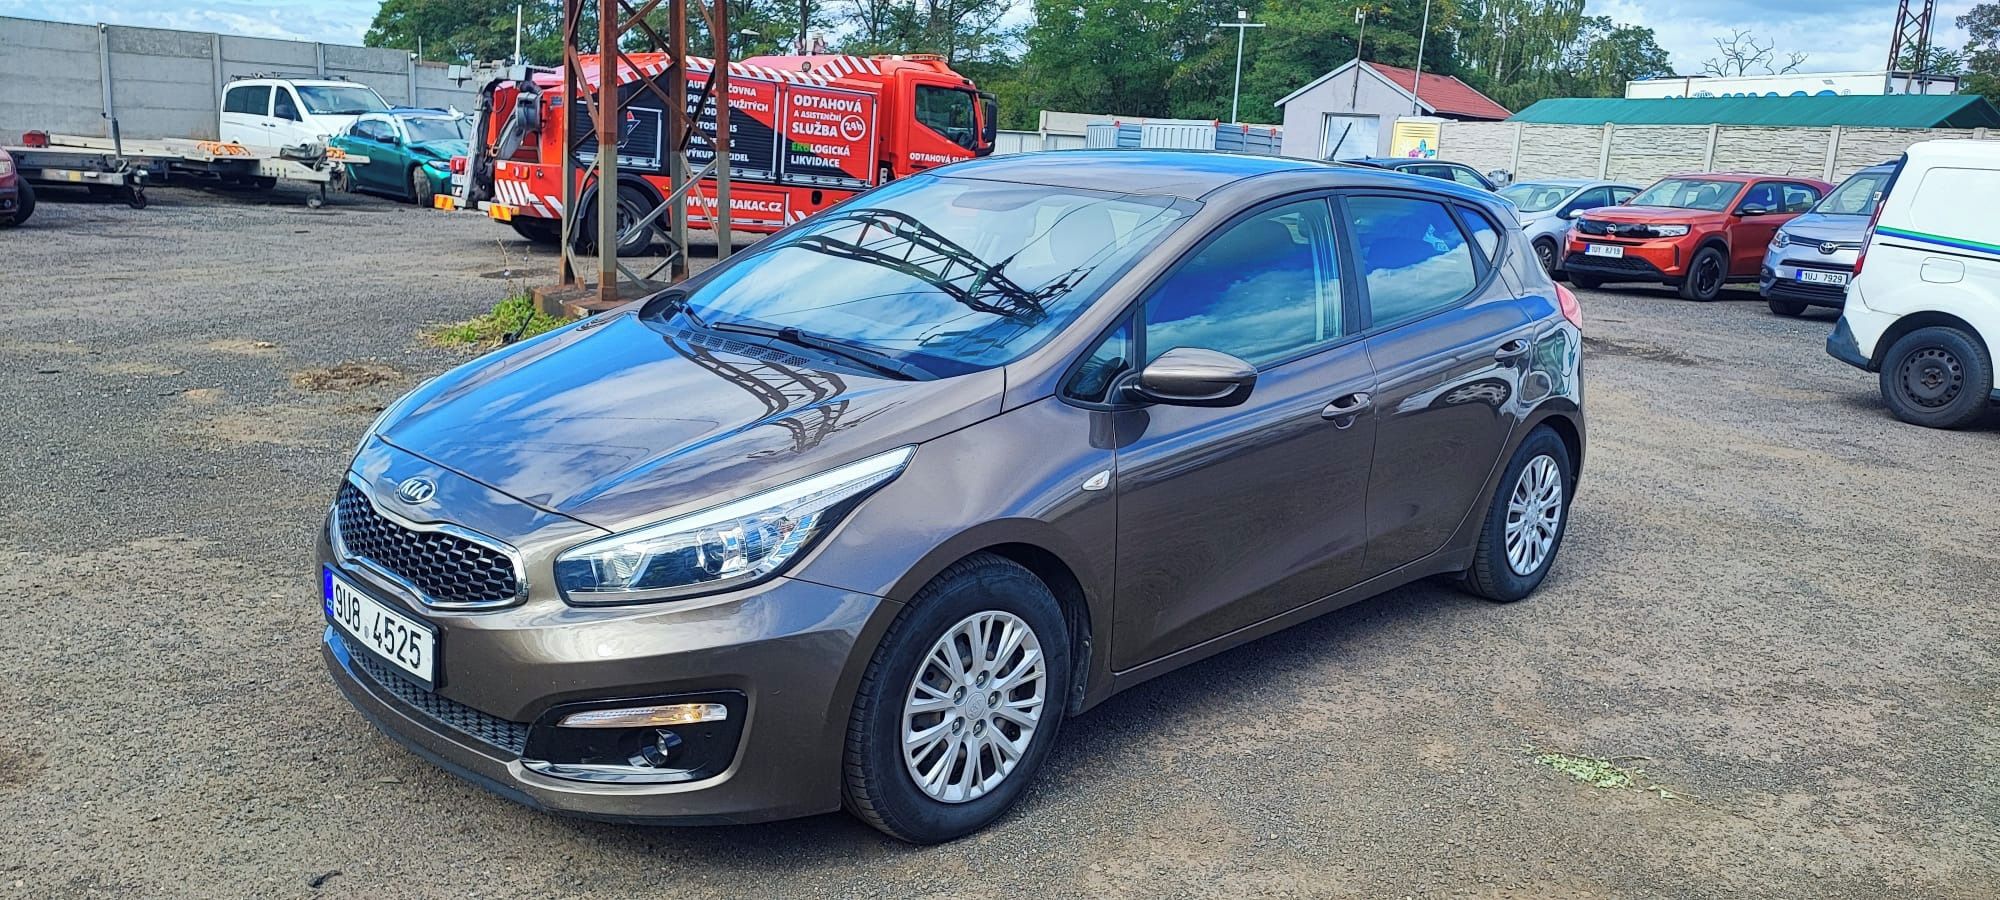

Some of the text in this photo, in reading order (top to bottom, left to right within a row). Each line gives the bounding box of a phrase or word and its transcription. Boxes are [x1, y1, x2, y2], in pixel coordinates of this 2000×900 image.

[728, 98, 769, 112] OUŽITÝCH
[793, 94, 862, 113] ODTAHOVÁ
[791, 121, 839, 137] SLUŽBA
[844, 121, 863, 131] 24h
[685, 148, 714, 159] VÝKUP
[791, 142, 850, 156] EKOLOGICKÁ
[790, 154, 841, 168] LIKVIDACE
[909, 152, 951, 164] ODTAHOVÁ
[1804, 272, 1843, 284] 1UJ 7929
[401, 482, 428, 500] KIA
[335, 583, 422, 670] 9U8 4525
